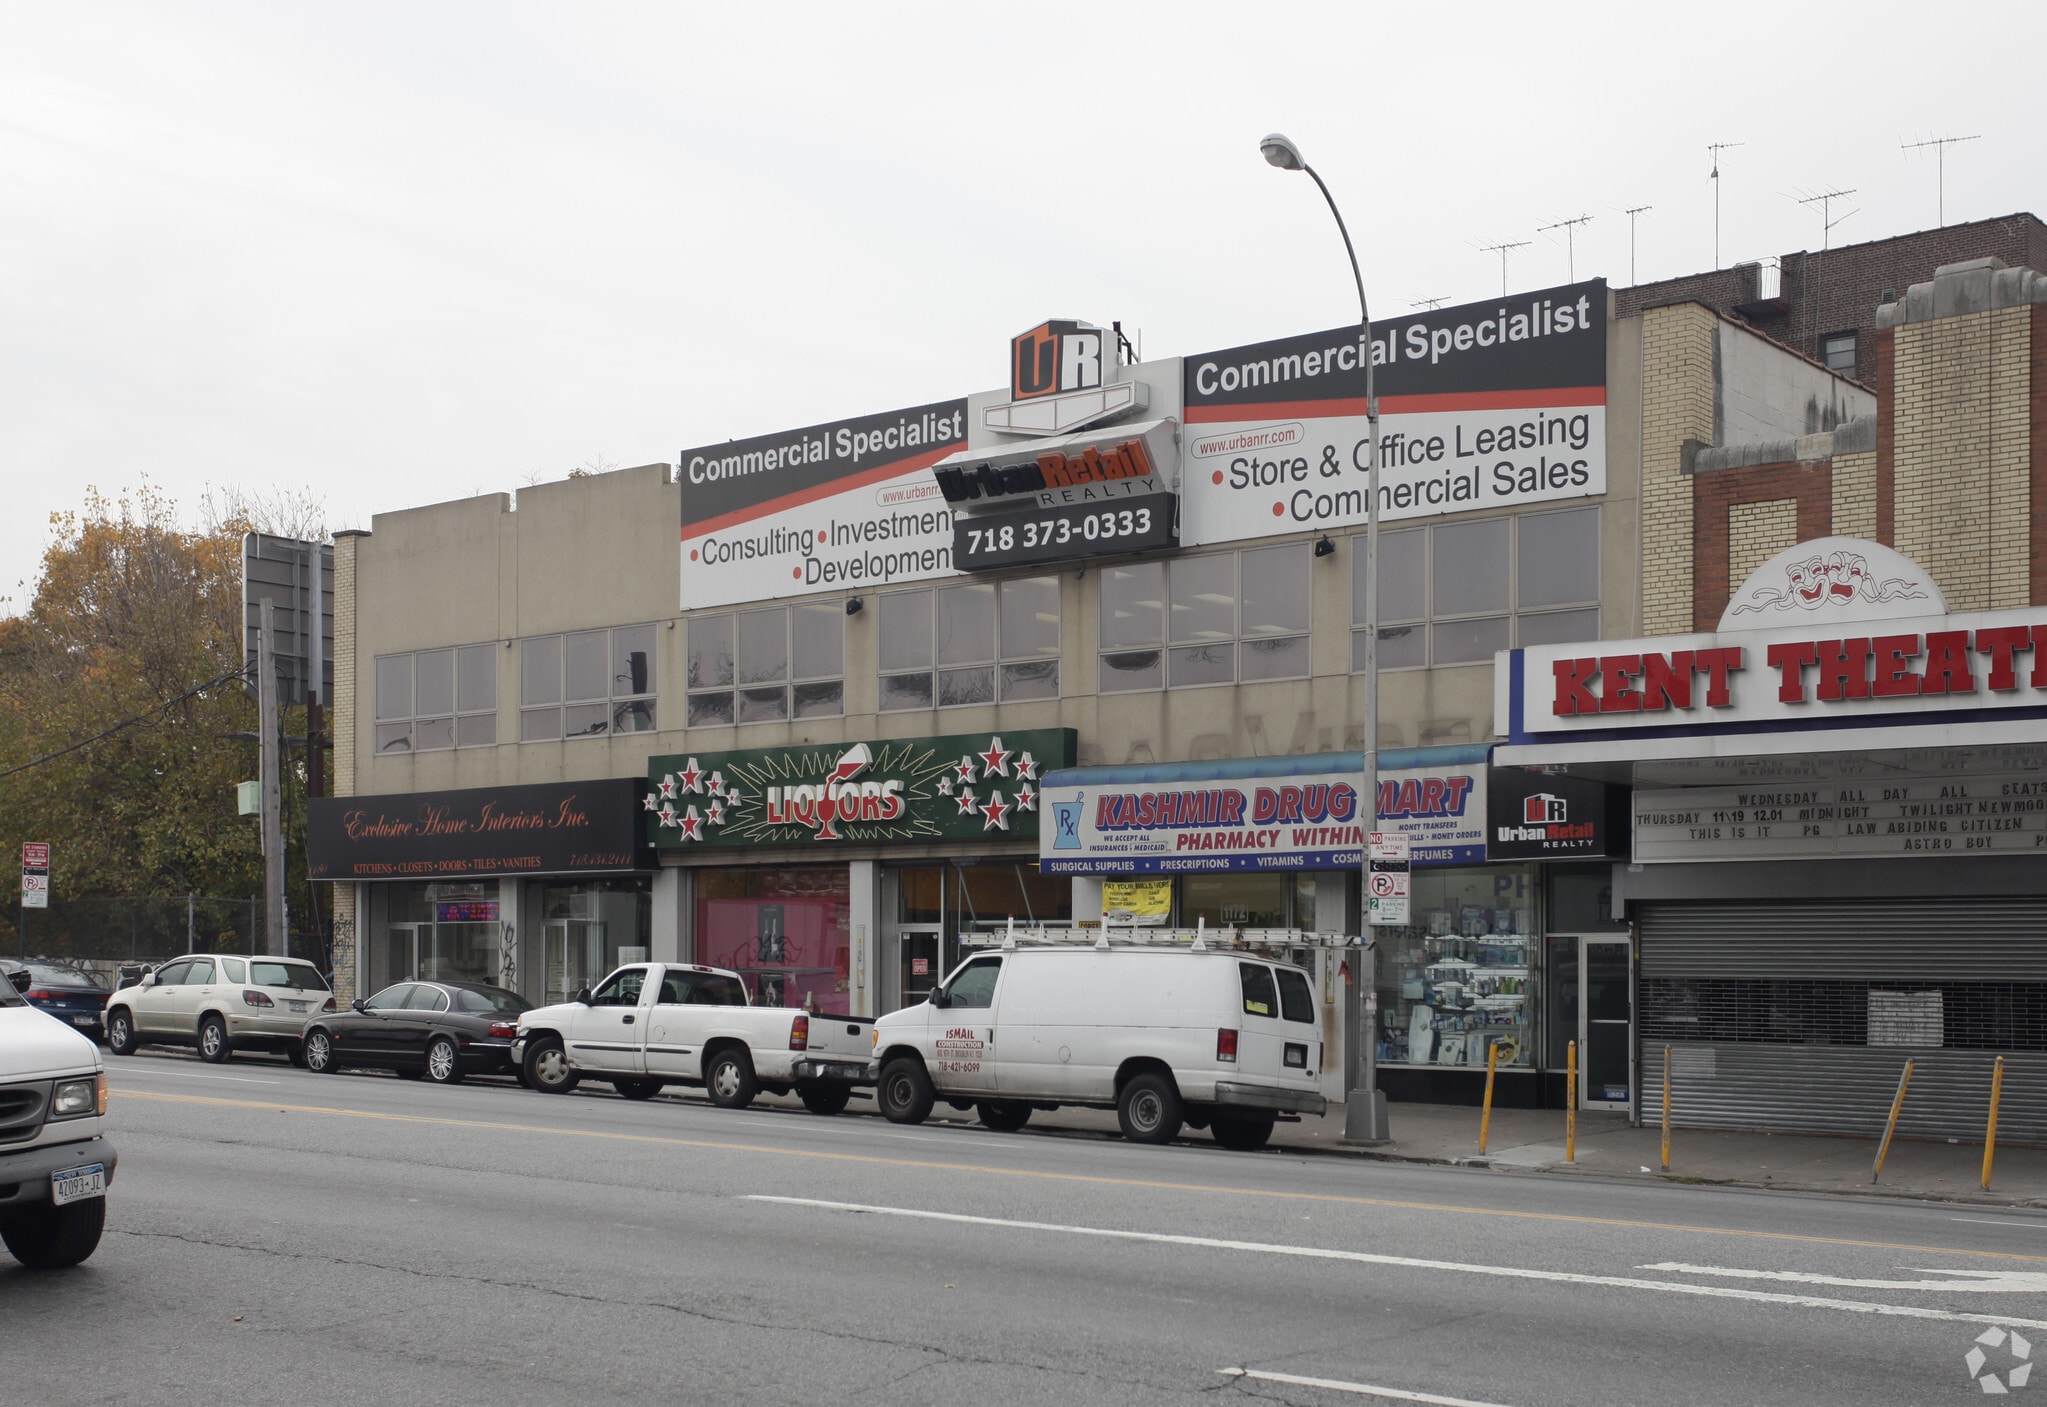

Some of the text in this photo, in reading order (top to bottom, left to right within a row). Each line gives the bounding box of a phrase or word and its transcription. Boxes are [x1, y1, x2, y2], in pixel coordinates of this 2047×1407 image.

[1196, 294, 1591, 396] Commercial Specialist
[1015, 322, 1101, 400] UR
[688, 409, 962, 484] Commercial Specialist
[1199, 427, 1296, 455] www.urbanrr.com
[1228, 412, 1590, 490] Store & Office Leasing
[1041, 478, 1155, 505] REALTY
[1290, 458, 1590, 522] Commercial Sales
[701, 508, 957, 566] Consulting Investment
[967, 508, 1151, 555] 718 373-0333
[1553, 646, 1747, 717] KENT
[766, 779, 905, 829] LIQUORS
[1738, 782, 2047, 806] WEDNESDAY ALL DAY ALL SEATS
[343, 810, 413, 842] Exclusive
[415, 802, 468, 836] Home
[547, 794, 590, 829] Inc.
[1095, 788, 1248, 832] KASHMIR
[1252, 781, 1358, 826] DRUG
[1636, 813, 1700, 825] THURSDAY
[1712, 811, 1745, 823] 11\19
[1753, 809, 1783, 822] 12.01
[1900, 802, 1973, 817] TWILIGHT
[1398, 821, 1458, 831] MONEY TRANSFERS
[1431, 832, 1455, 840] MONEY
[1456, 830, 1482, 839] ORDERS
[1689, 817, 2023, 840] THIS IS IT PG LAW ABIDING CITIZEN
[1089, 843, 1165, 852] INSURANCES MEDICAID
[1115, 834, 1137, 842] ACCEPT
[1138, 834, 1150, 842] ALL
[1176, 826, 1364, 851] PHARMACY WITHIN
[1370, 833, 1382, 844] NO
[1543, 840, 1594, 849] REALTY
[1904, 834, 2047, 850] ASTRO BOY P
[353, 856, 542, 874] KITCHENS CLOSETS DOORS TILES VANITIES
[1051, 861, 1093, 872] SURGICAL
[1095, 860, 1135, 871] SUPPLIES
[1160, 858, 1230, 870] PRESCRIPTIONS
[1257, 856, 1304, 867] VITAMINS
[1409, 850, 1453, 861] ERFUMES
[1370, 898, 1378, 909] 2
[937, 1040, 982, 1049] CONSTRUCTION
[945, 1027, 975, 1040] ISMAIL
[938, 1061, 980, 1073] 718-421-6099
[58, 1178, 84, 1198] 42093
